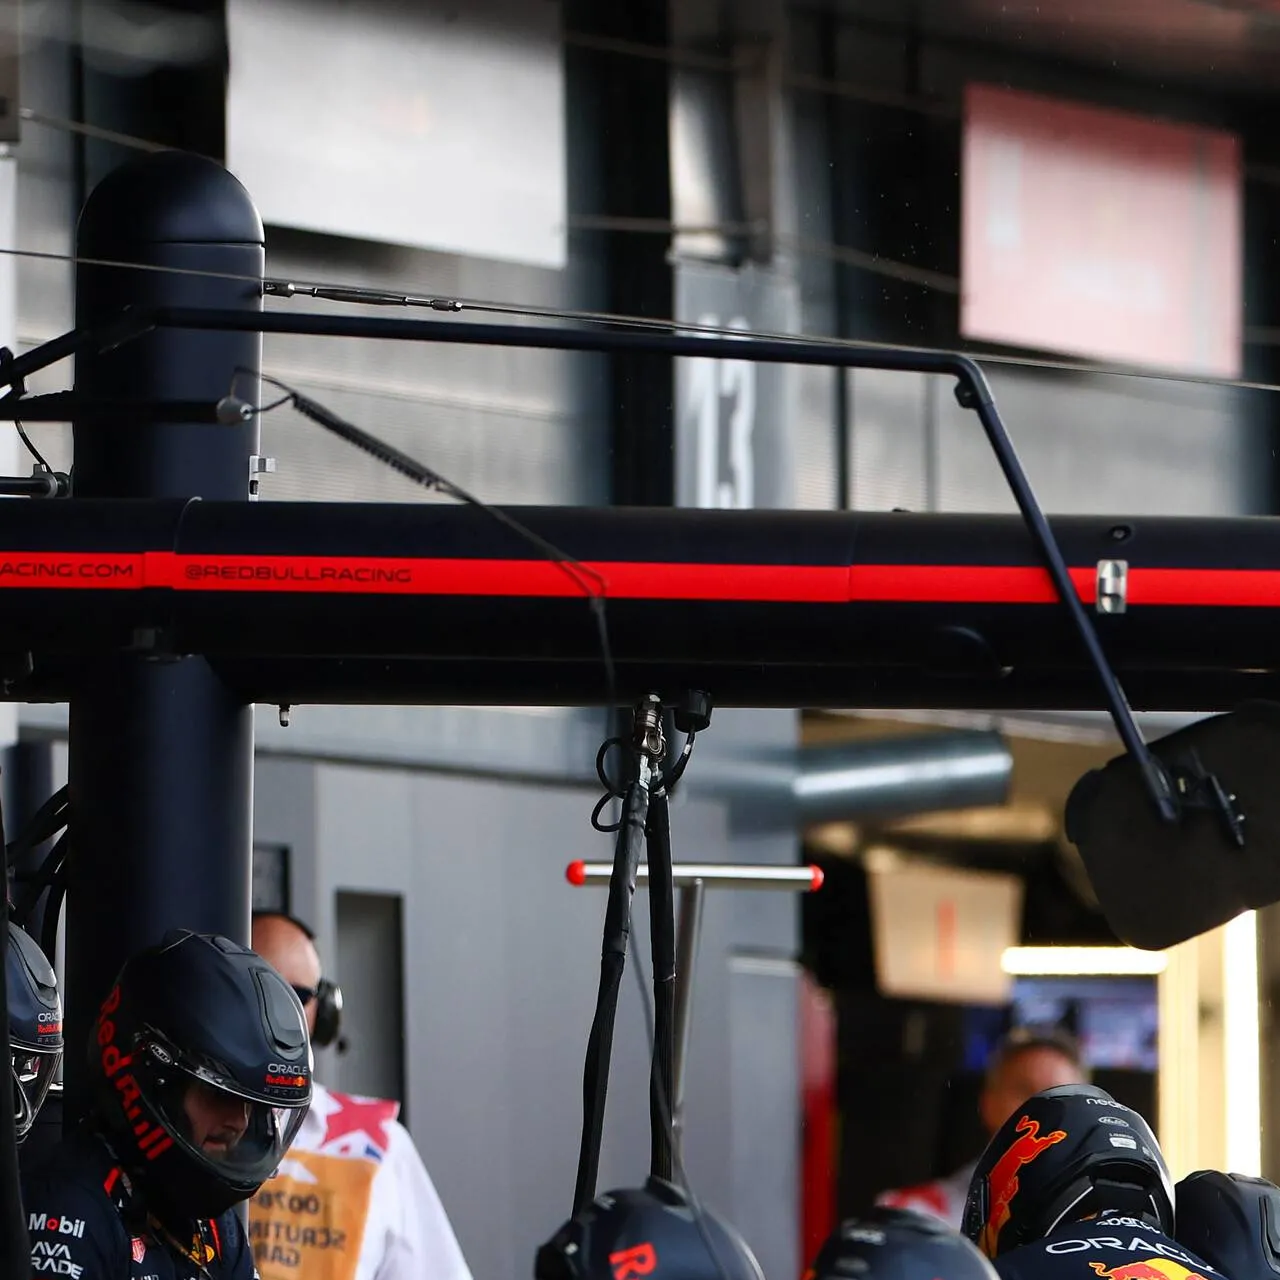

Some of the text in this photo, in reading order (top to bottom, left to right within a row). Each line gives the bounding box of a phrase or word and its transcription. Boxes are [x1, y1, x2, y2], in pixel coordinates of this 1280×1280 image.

[185, 564, 412, 583] @REDBULLRACING
[29, 1213, 85, 1239] Mobil
[32, 1241, 71, 1259] AVA
[31, 1257, 83, 1280] RADE
